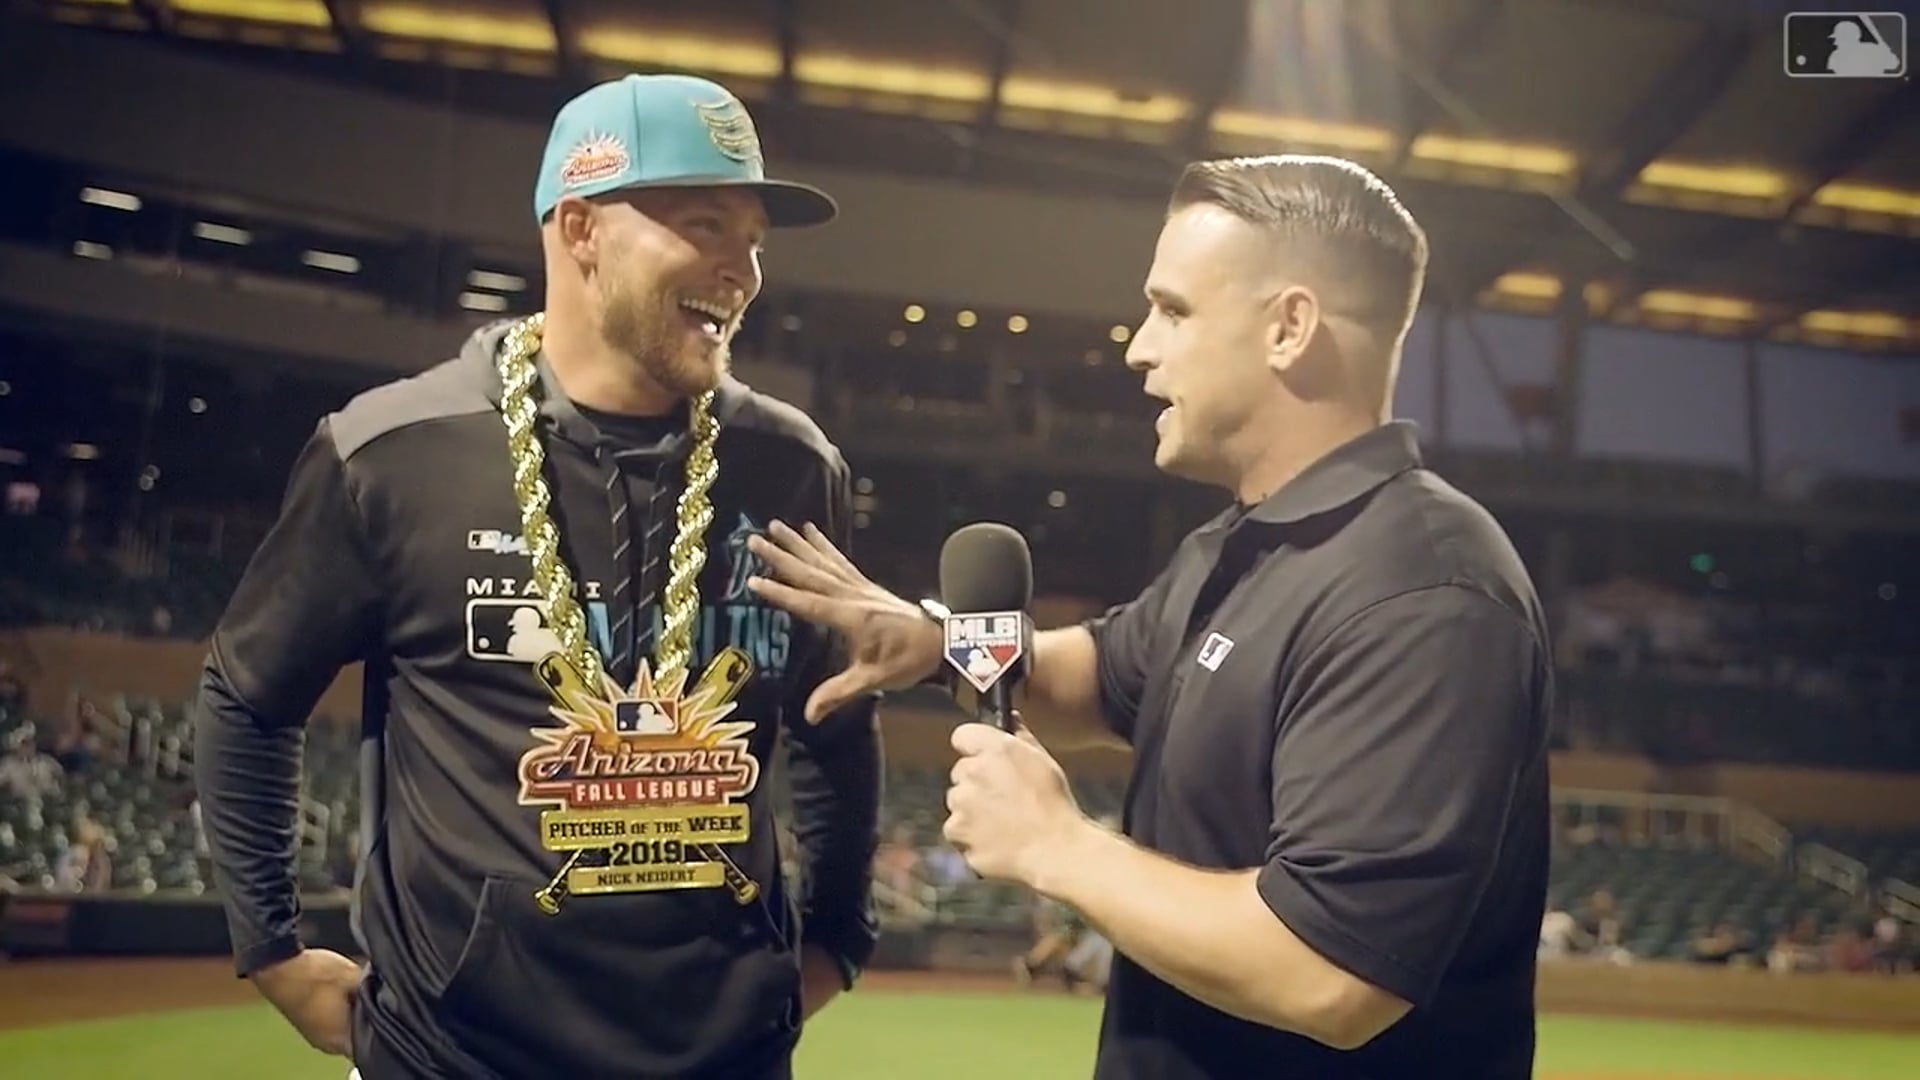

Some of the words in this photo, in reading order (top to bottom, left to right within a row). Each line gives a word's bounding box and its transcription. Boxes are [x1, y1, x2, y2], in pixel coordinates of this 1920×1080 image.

[466, 578, 601, 598] MIAI
[950, 617, 1017, 640] MLB
[535, 735, 747, 778] Arizona
[575, 783, 626, 802] FALL
[637, 779, 717, 799] LEAGUE
[550, 820, 626, 838] PITCHER
[631, 823, 648, 835] OF
[653, 821, 682, 835] THE
[687, 815, 743, 832] WEEK
[612, 841, 683, 866] 2019
[597, 873, 632, 886] NICK
[636, 870, 696, 885] NEIDERT
